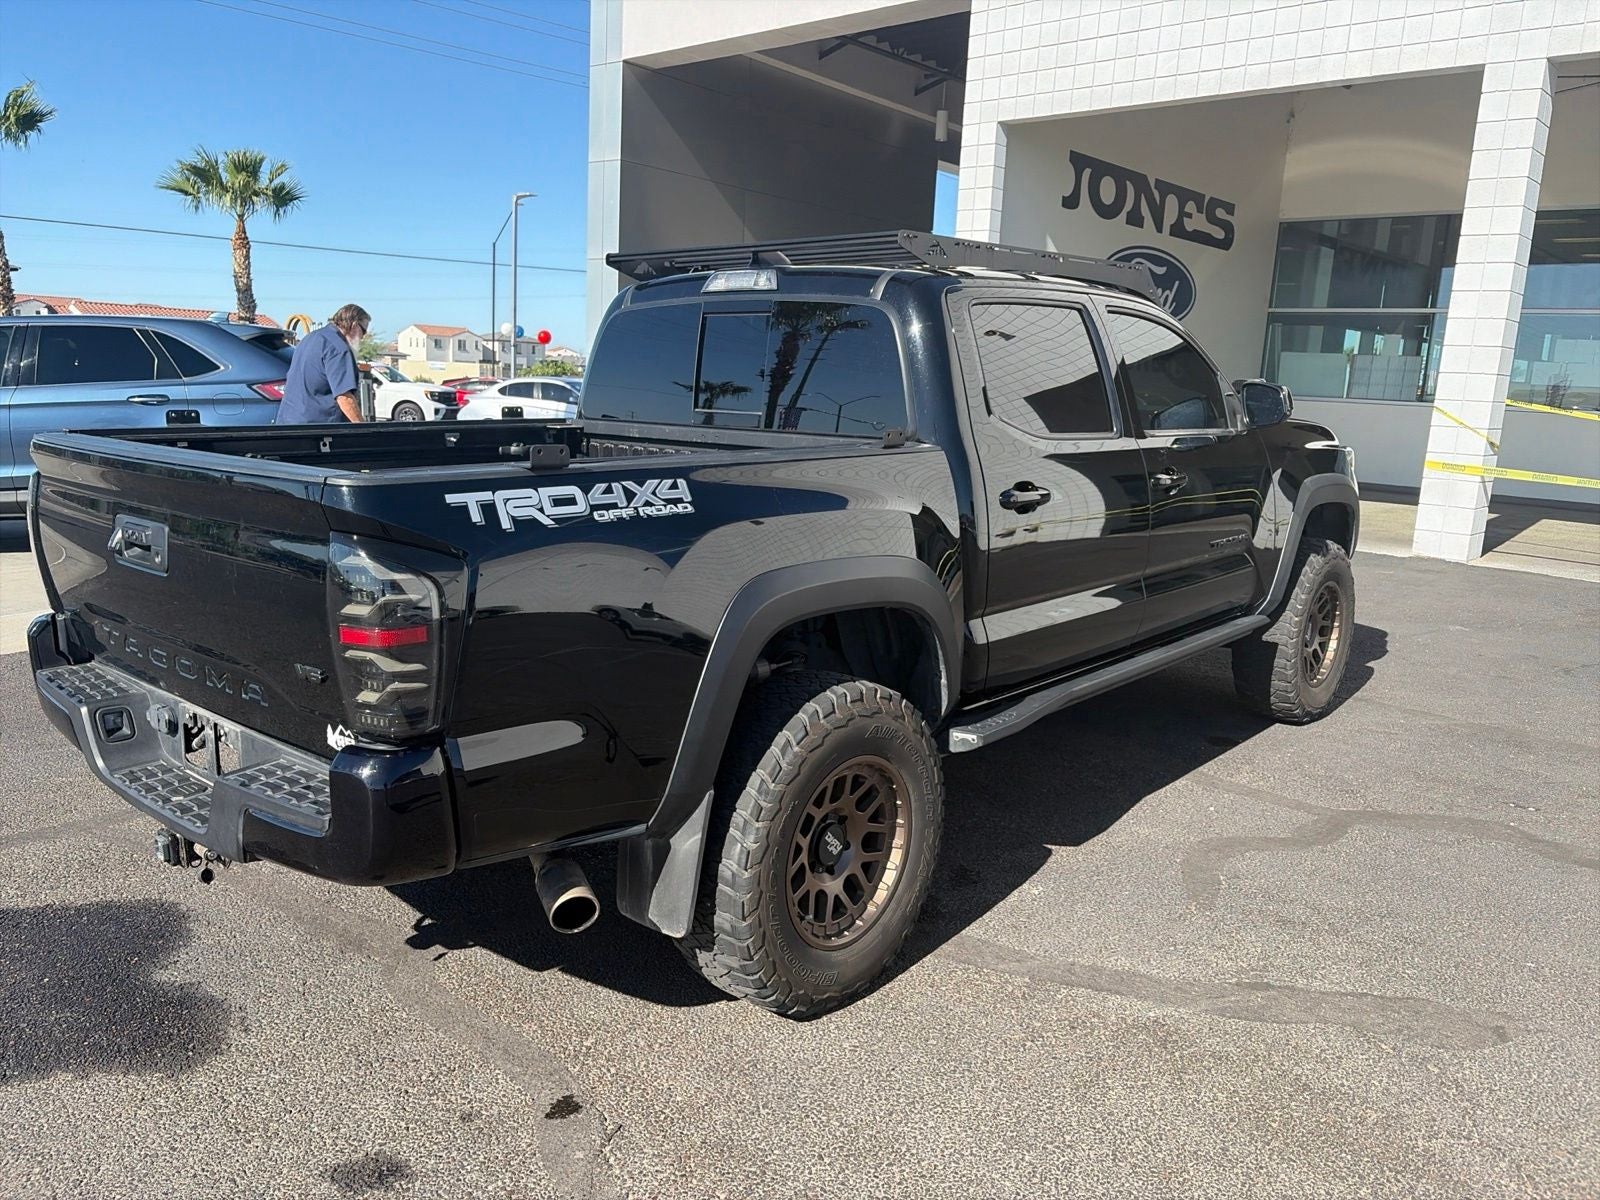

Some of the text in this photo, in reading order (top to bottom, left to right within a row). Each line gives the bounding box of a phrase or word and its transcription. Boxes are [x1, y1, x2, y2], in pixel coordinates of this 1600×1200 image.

[1061, 149, 1236, 251] JONES
[444, 485, 591, 532] TRD
[593, 503, 695, 522] OFF ROAD
[103, 624, 269, 707] TACOMA
